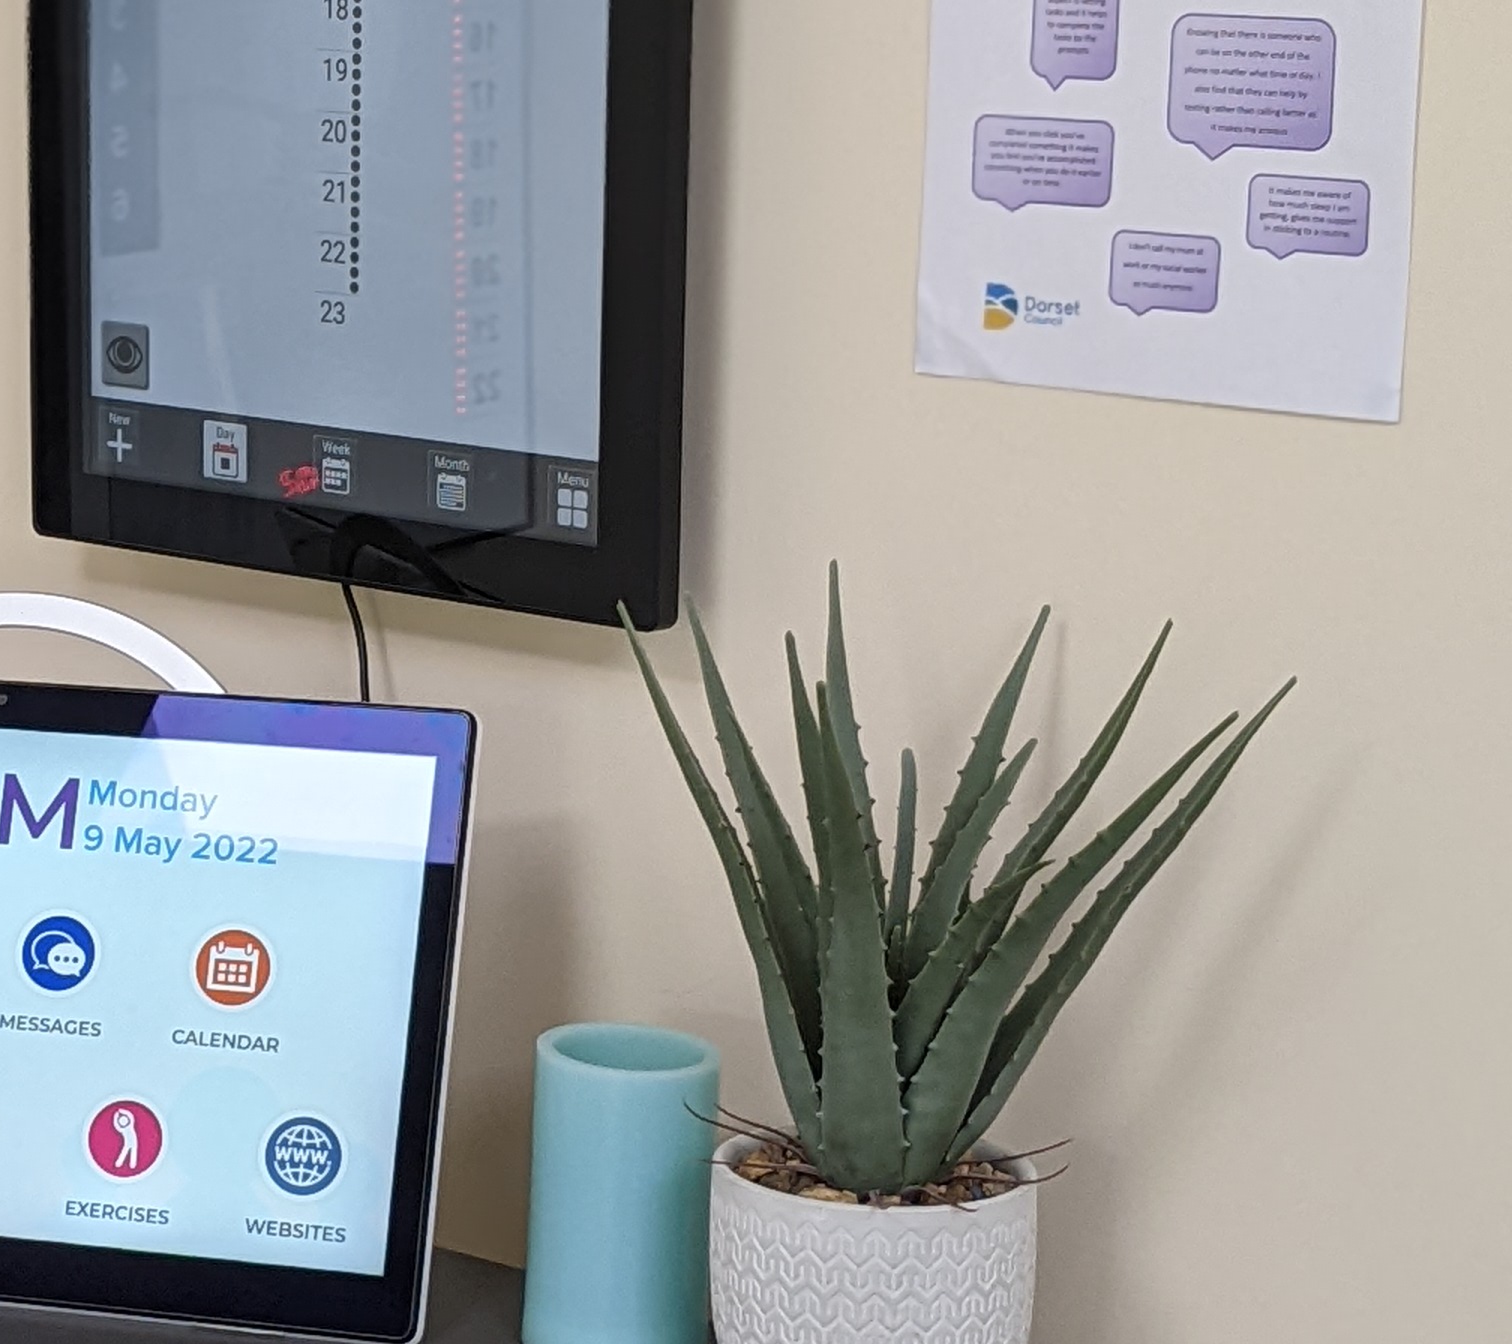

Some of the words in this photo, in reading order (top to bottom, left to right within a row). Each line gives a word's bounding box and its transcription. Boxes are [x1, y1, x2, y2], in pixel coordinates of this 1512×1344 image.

[322, 57, 348, 82] 19
[320, 118, 347, 144] 20
[321, 178, 346, 204] 21
[319, 239, 346, 265] 22
[319, 300, 346, 325] 23
[1024, 296, 1080, 316] Dorset
[1023, 313, 1064, 327] Council
[109, 412, 131, 426] New
[215, 425, 236, 443] Day
[321, 439, 352, 456] Week
[434, 455, 471, 472] Month
[557, 471, 589, 488] Menu
[88, 778, 218, 820] Monday
[83, 824, 104, 852] 9
[114, 826, 182, 863] May
[190, 833, 279, 865] 2022
[0, 1014, 102, 1037] MESSAGES
[171, 1029, 280, 1053] CALENDAR
[65, 1199, 170, 1225] EXERCISES
[245, 1217, 348, 1243] WEBSITES
